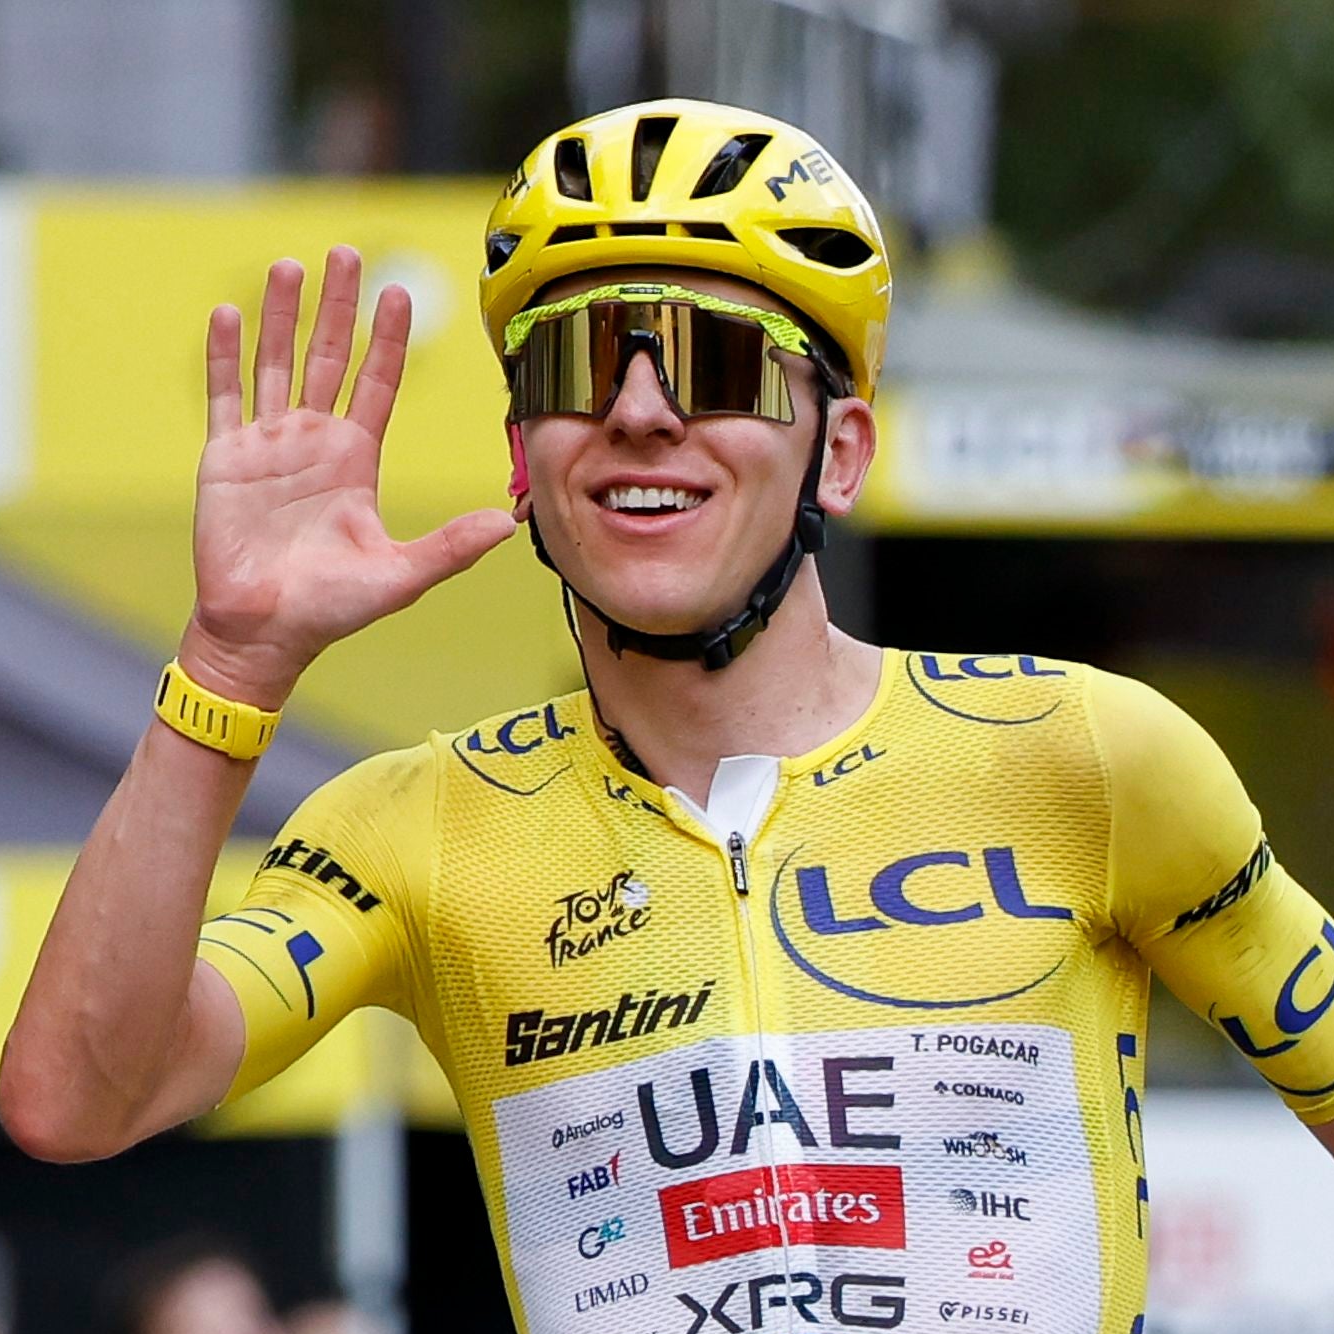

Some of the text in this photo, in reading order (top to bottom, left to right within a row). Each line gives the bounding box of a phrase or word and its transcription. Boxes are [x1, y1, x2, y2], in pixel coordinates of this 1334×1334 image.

[919, 653, 1066, 681] LCL
[467, 703, 575, 754] LCL
[814, 744, 888, 787] LCL
[796, 847, 1074, 935] LCL
[505, 980, 717, 1066] Santini
[911, 1034, 1040, 1066] T. POGACAR
[637, 1056, 901, 1169] UAE
[952, 1083, 1025, 1106] COLNAGO
[566, 1110, 625, 1143] Analog
[567, 1166, 610, 1200] FAB
[681, 1187, 881, 1242] Emirates
[980, 1191, 1031, 1222] IHC
[578, 1216, 626, 1259] G42
[961, 1305, 1029, 1325] PISSEI
